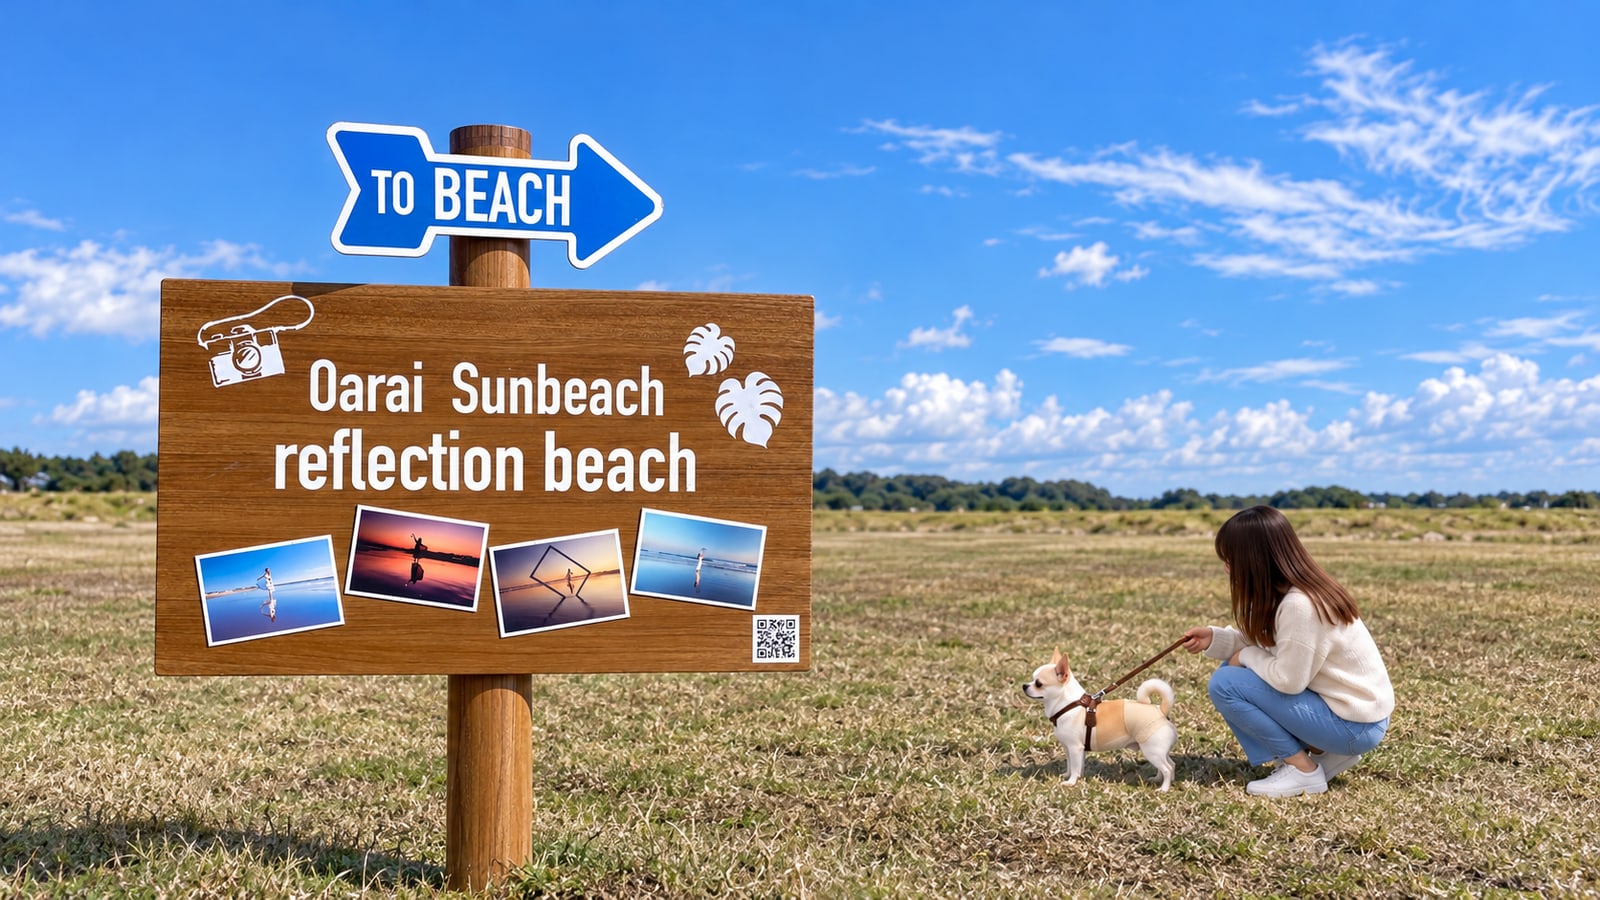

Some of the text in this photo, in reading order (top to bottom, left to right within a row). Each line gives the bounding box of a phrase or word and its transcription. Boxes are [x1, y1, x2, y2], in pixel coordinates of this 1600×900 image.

[371, 167, 571, 227] TO BEACH
[309, 358, 665, 417] Oarai Sunbeach
[274, 428, 697, 493] reflection beach
